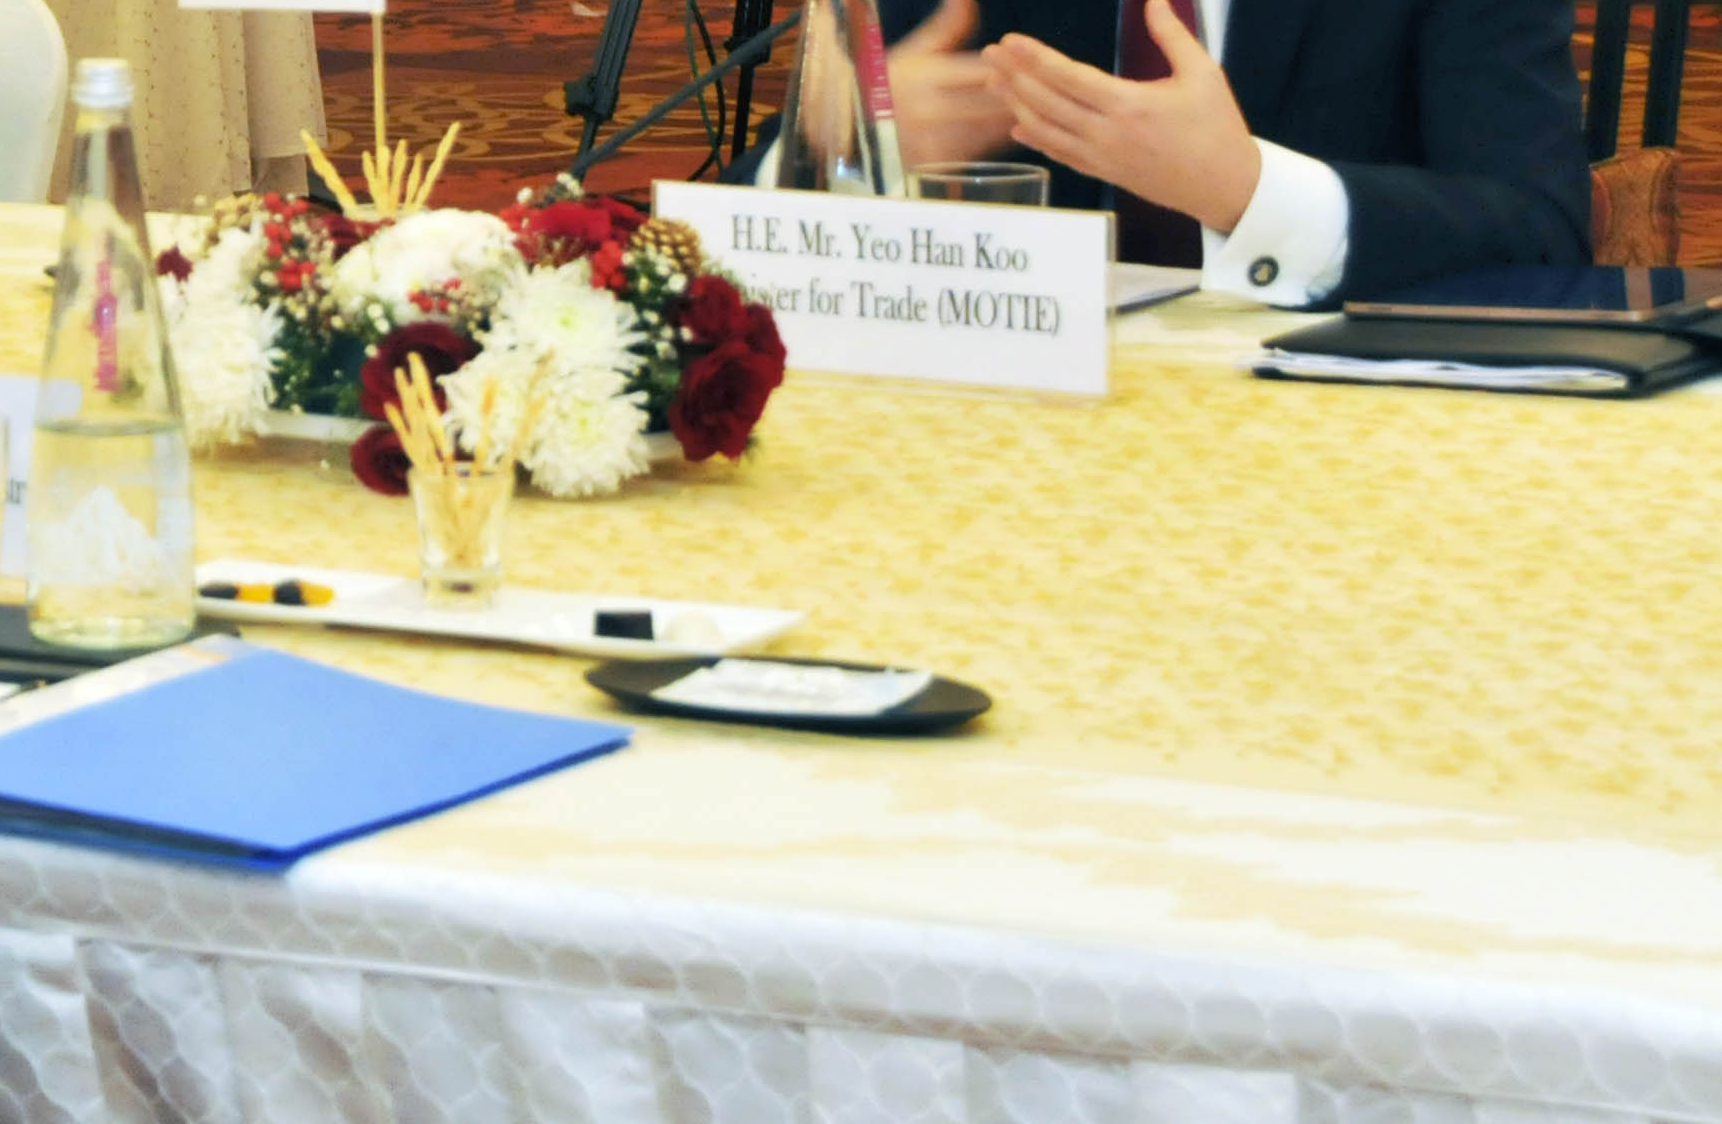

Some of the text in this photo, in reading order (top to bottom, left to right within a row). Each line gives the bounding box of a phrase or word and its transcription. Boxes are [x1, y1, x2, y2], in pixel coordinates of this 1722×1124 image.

[731, 214, 1030, 272] H.E. Mr. Yeo Han Koo
[808, 277, 844, 316] for
[850, 280, 928, 322] Trade
[937, 287, 1061, 335] (MOTIE)
